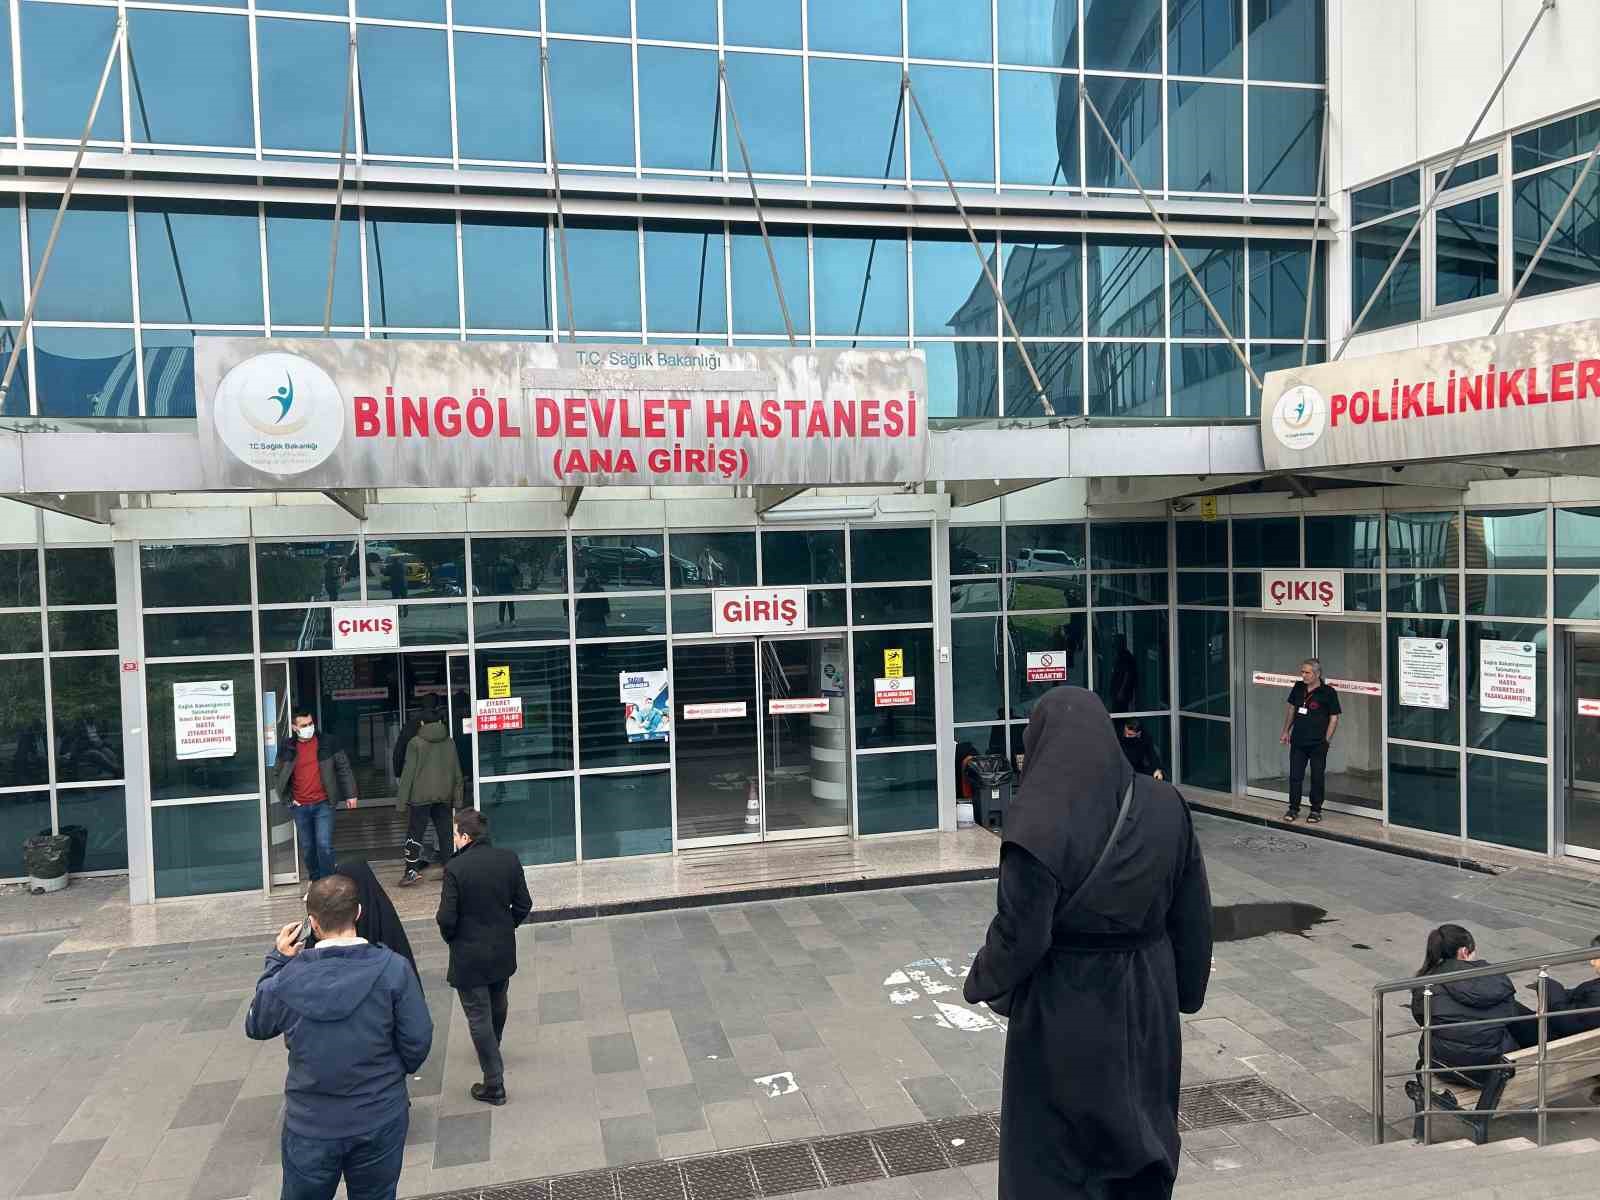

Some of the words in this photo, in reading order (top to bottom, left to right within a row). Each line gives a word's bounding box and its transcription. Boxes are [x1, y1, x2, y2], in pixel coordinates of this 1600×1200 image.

[609, 351, 653, 369] Sağlık
[657, 352, 721, 370] Bakanlığı
[1330, 359, 1600, 427] POLİKLİNİKLER
[353, 386, 521, 438] BİNGÖL
[535, 397, 691, 438] DEVLET
[706, 391, 916, 438] HASTANESİ
[553, 449, 639, 480] (ANA
[649, 443, 749, 480] GİRİŞ)
[1270, 580, 1334, 607] ÇIKIŞ
[723, 594, 798, 626] GİRİŞ
[338, 618, 393, 636] ÇIKIŞ
